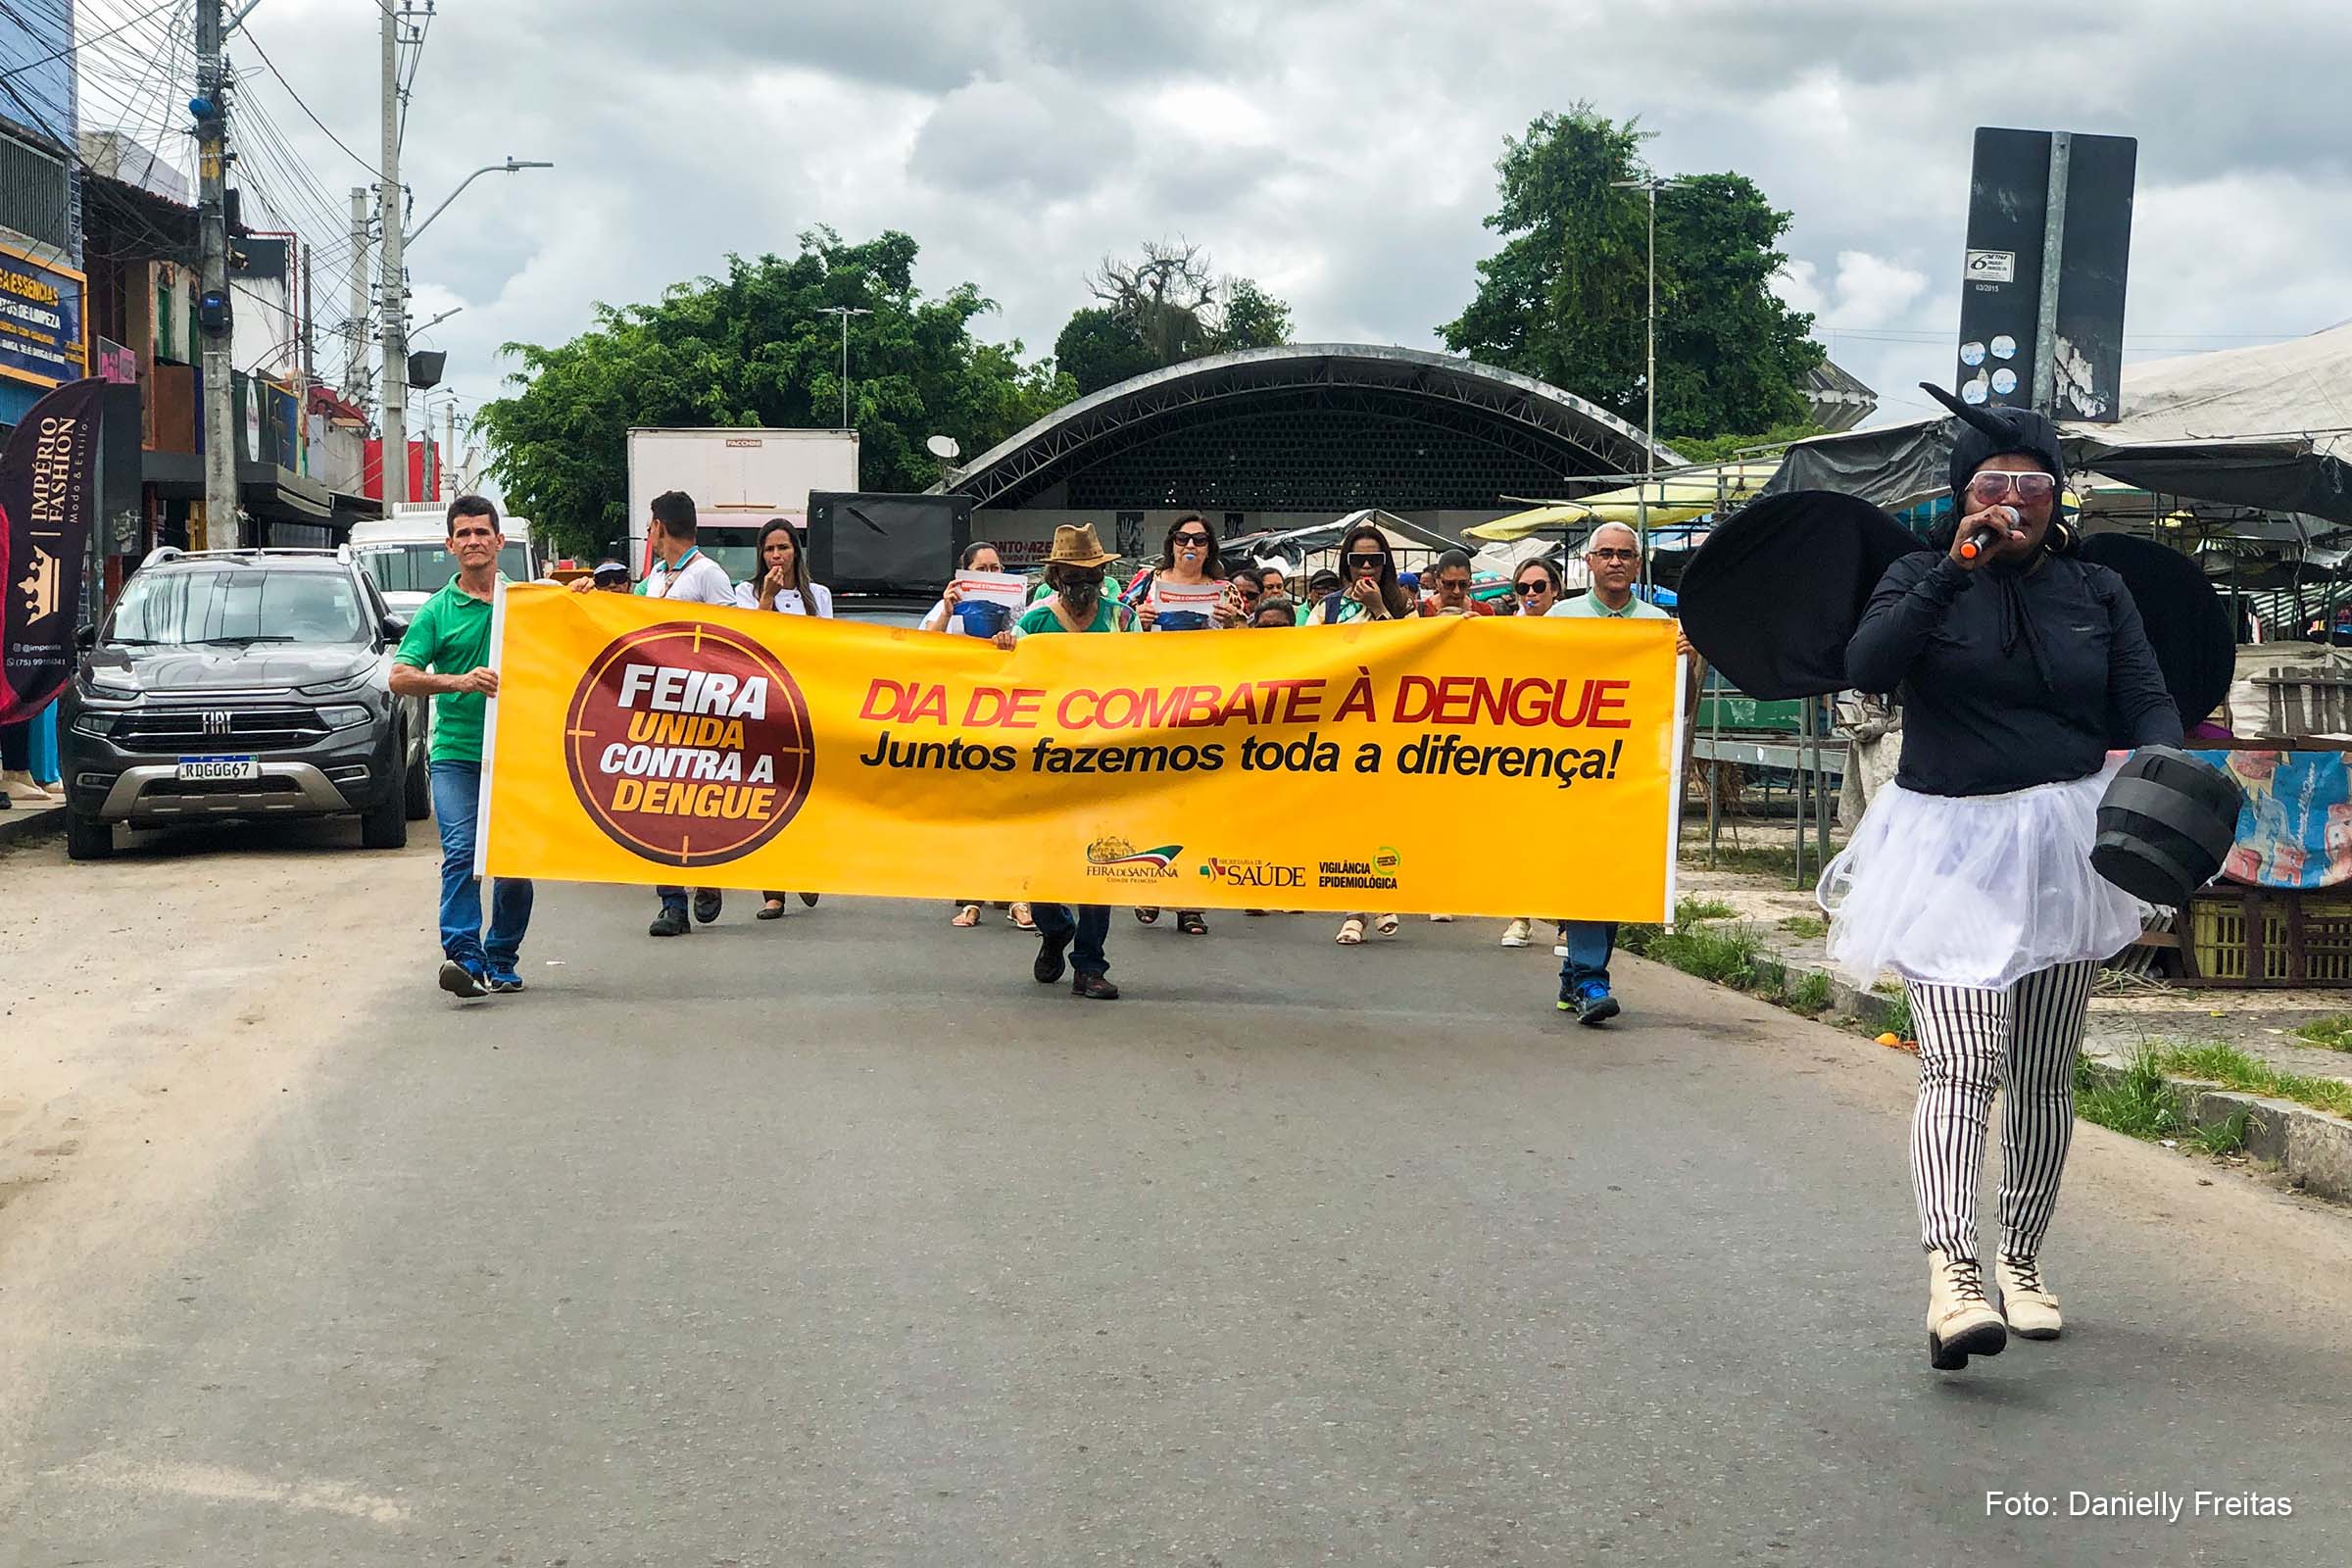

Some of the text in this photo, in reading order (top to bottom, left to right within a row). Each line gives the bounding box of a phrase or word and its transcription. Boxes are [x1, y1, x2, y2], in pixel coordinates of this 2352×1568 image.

[30, 307, 61, 330] LIMPEZA
[31, 416, 57, 521] IMPÉRIO
[49, 416, 77, 522] FASHION
[1028, 540, 1052, 553] AZE
[16, 658, 31, 667] (75)
[617, 663, 769, 720] FEIRA
[858, 666, 1632, 730] DIA DE COMBATE À DENGUE
[202, 711, 233, 735] FIAT
[627, 711, 745, 750] UNIDA
[600, 743, 775, 784] CONTRA A
[860, 731, 1624, 789] Juntos fazemos toda a diferença!
[611, 779, 777, 820] DENGUE
[1087, 866, 1114, 876] FEIRA
[1126, 868, 1178, 878] SANTANA
[1227, 862, 1306, 887] SAÚDE
[1319, 860, 1371, 875] VIGILÂNCIA
[1319, 875, 1397, 889] EPIDEMIOLÓGICA
